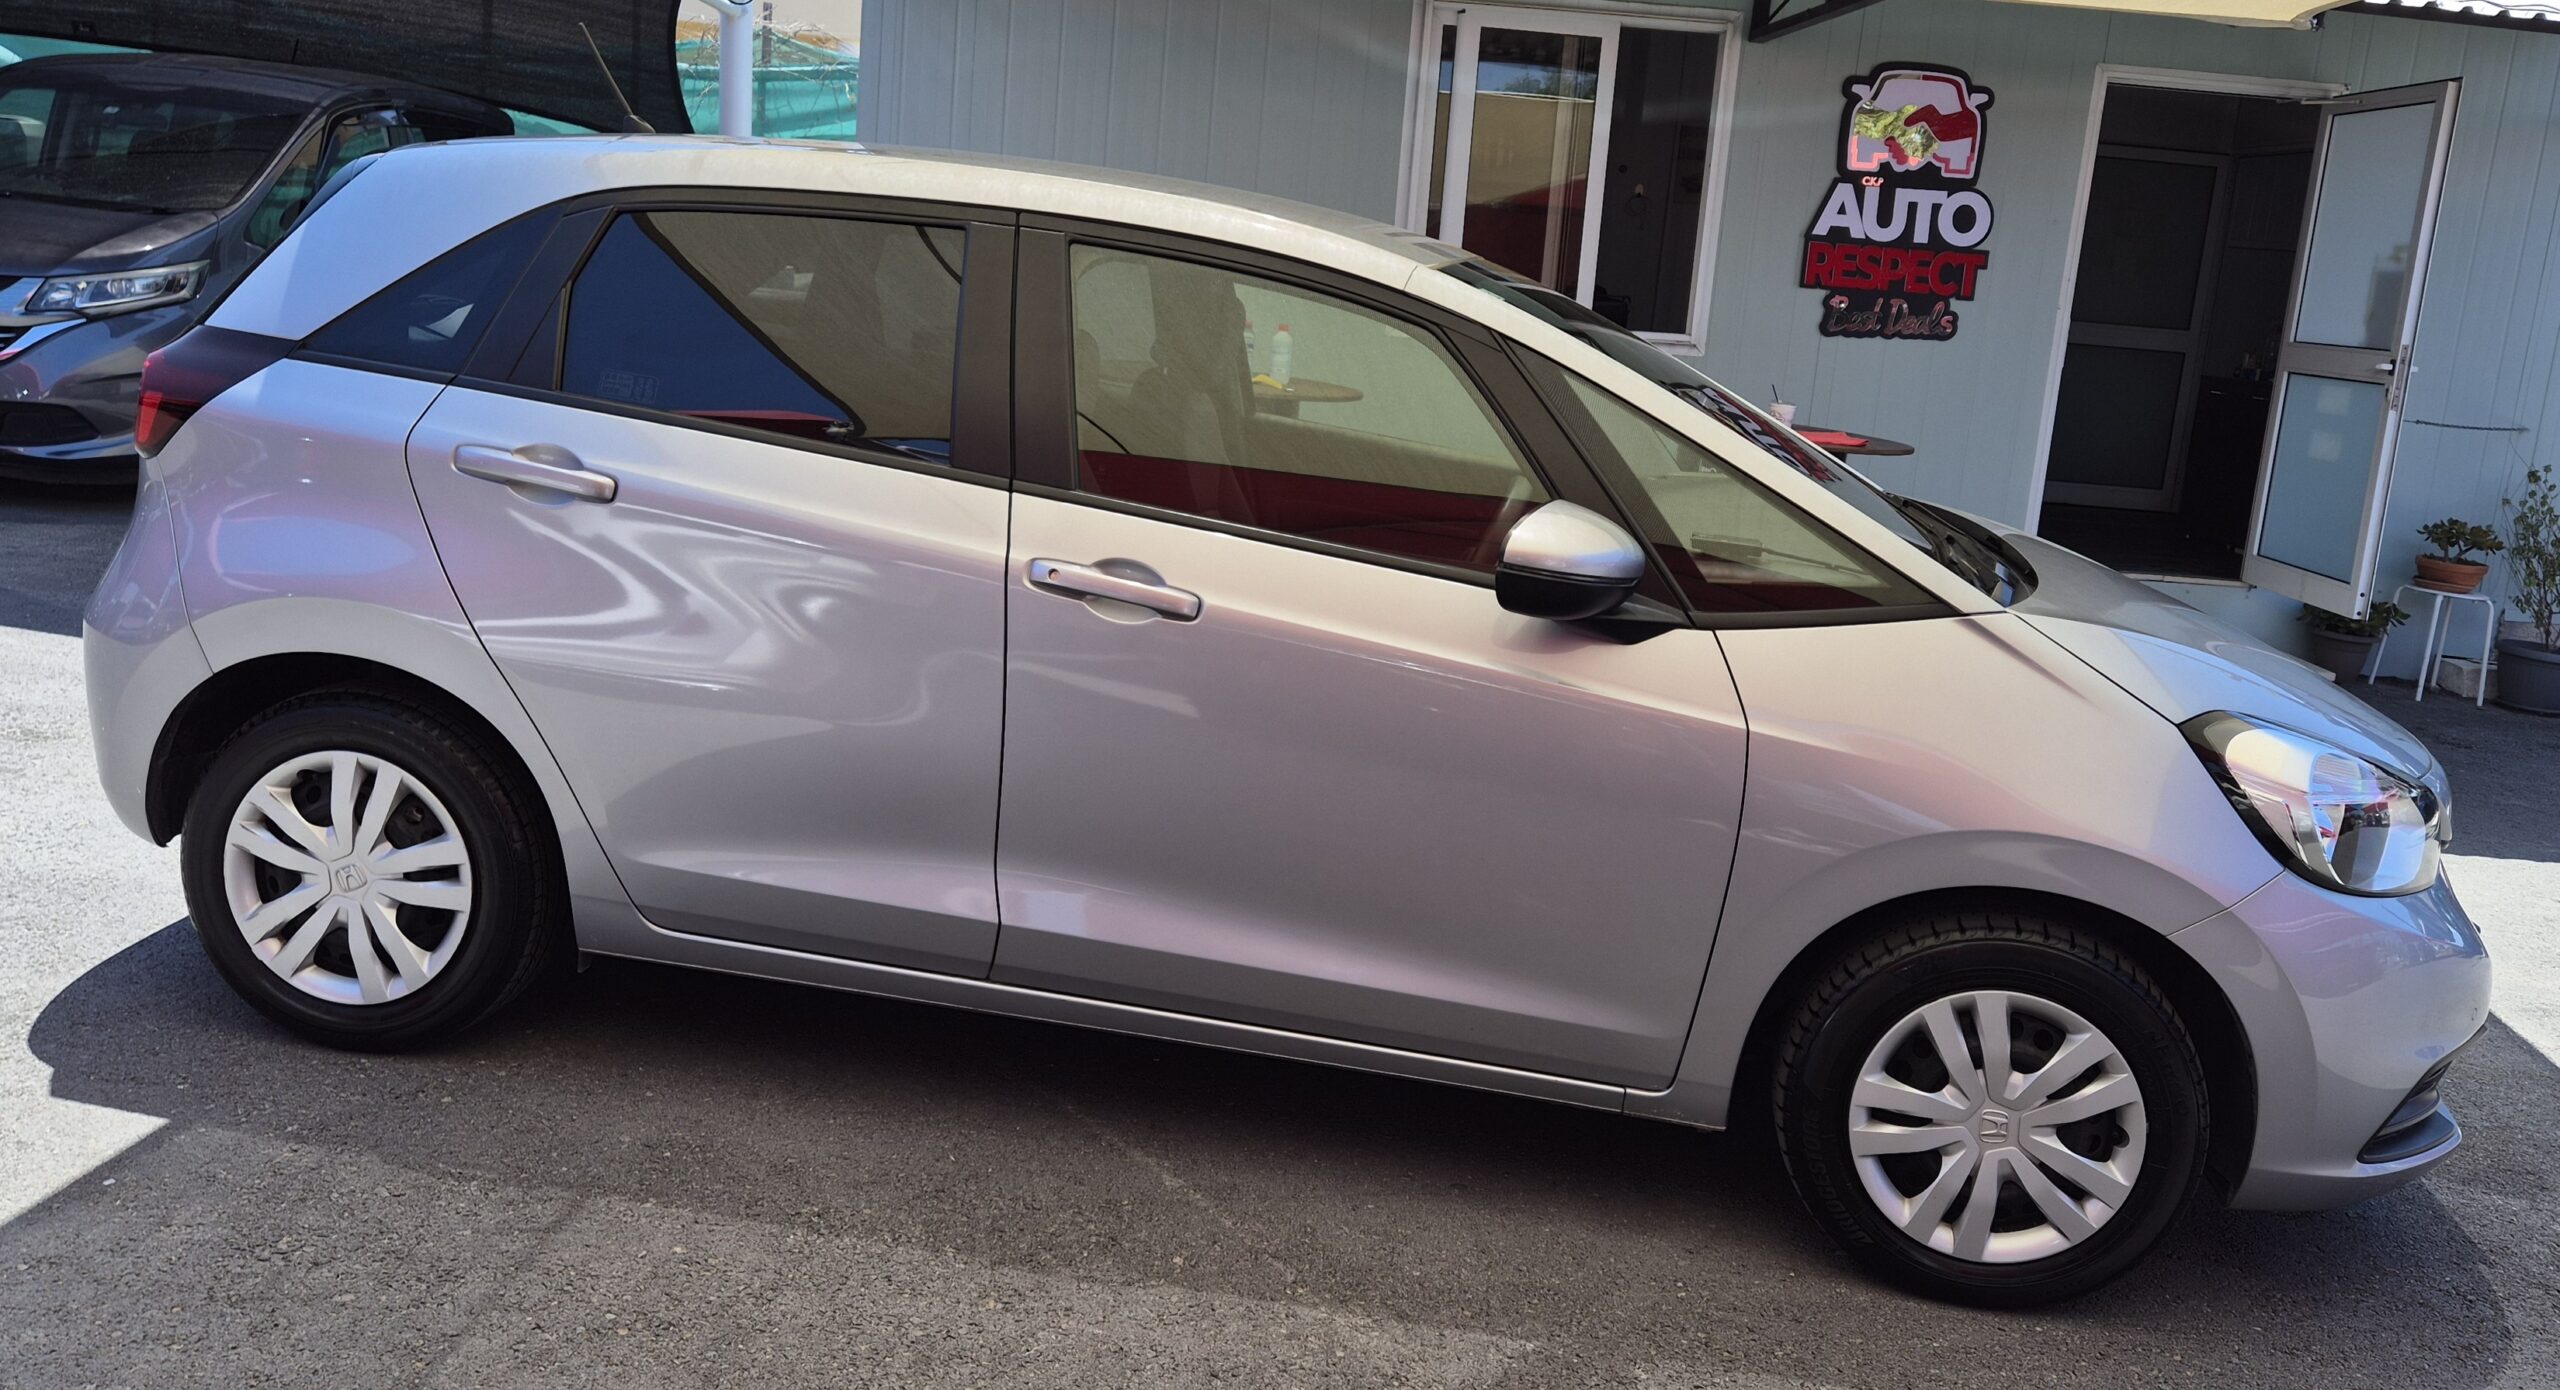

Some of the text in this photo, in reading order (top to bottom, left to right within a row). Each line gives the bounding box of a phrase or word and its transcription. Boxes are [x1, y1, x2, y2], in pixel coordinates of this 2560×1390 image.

[1811, 182, 1991, 247] AUTO
[1804, 241, 1985, 297] RESPECT
[1828, 294, 1954, 335] Best Deals
